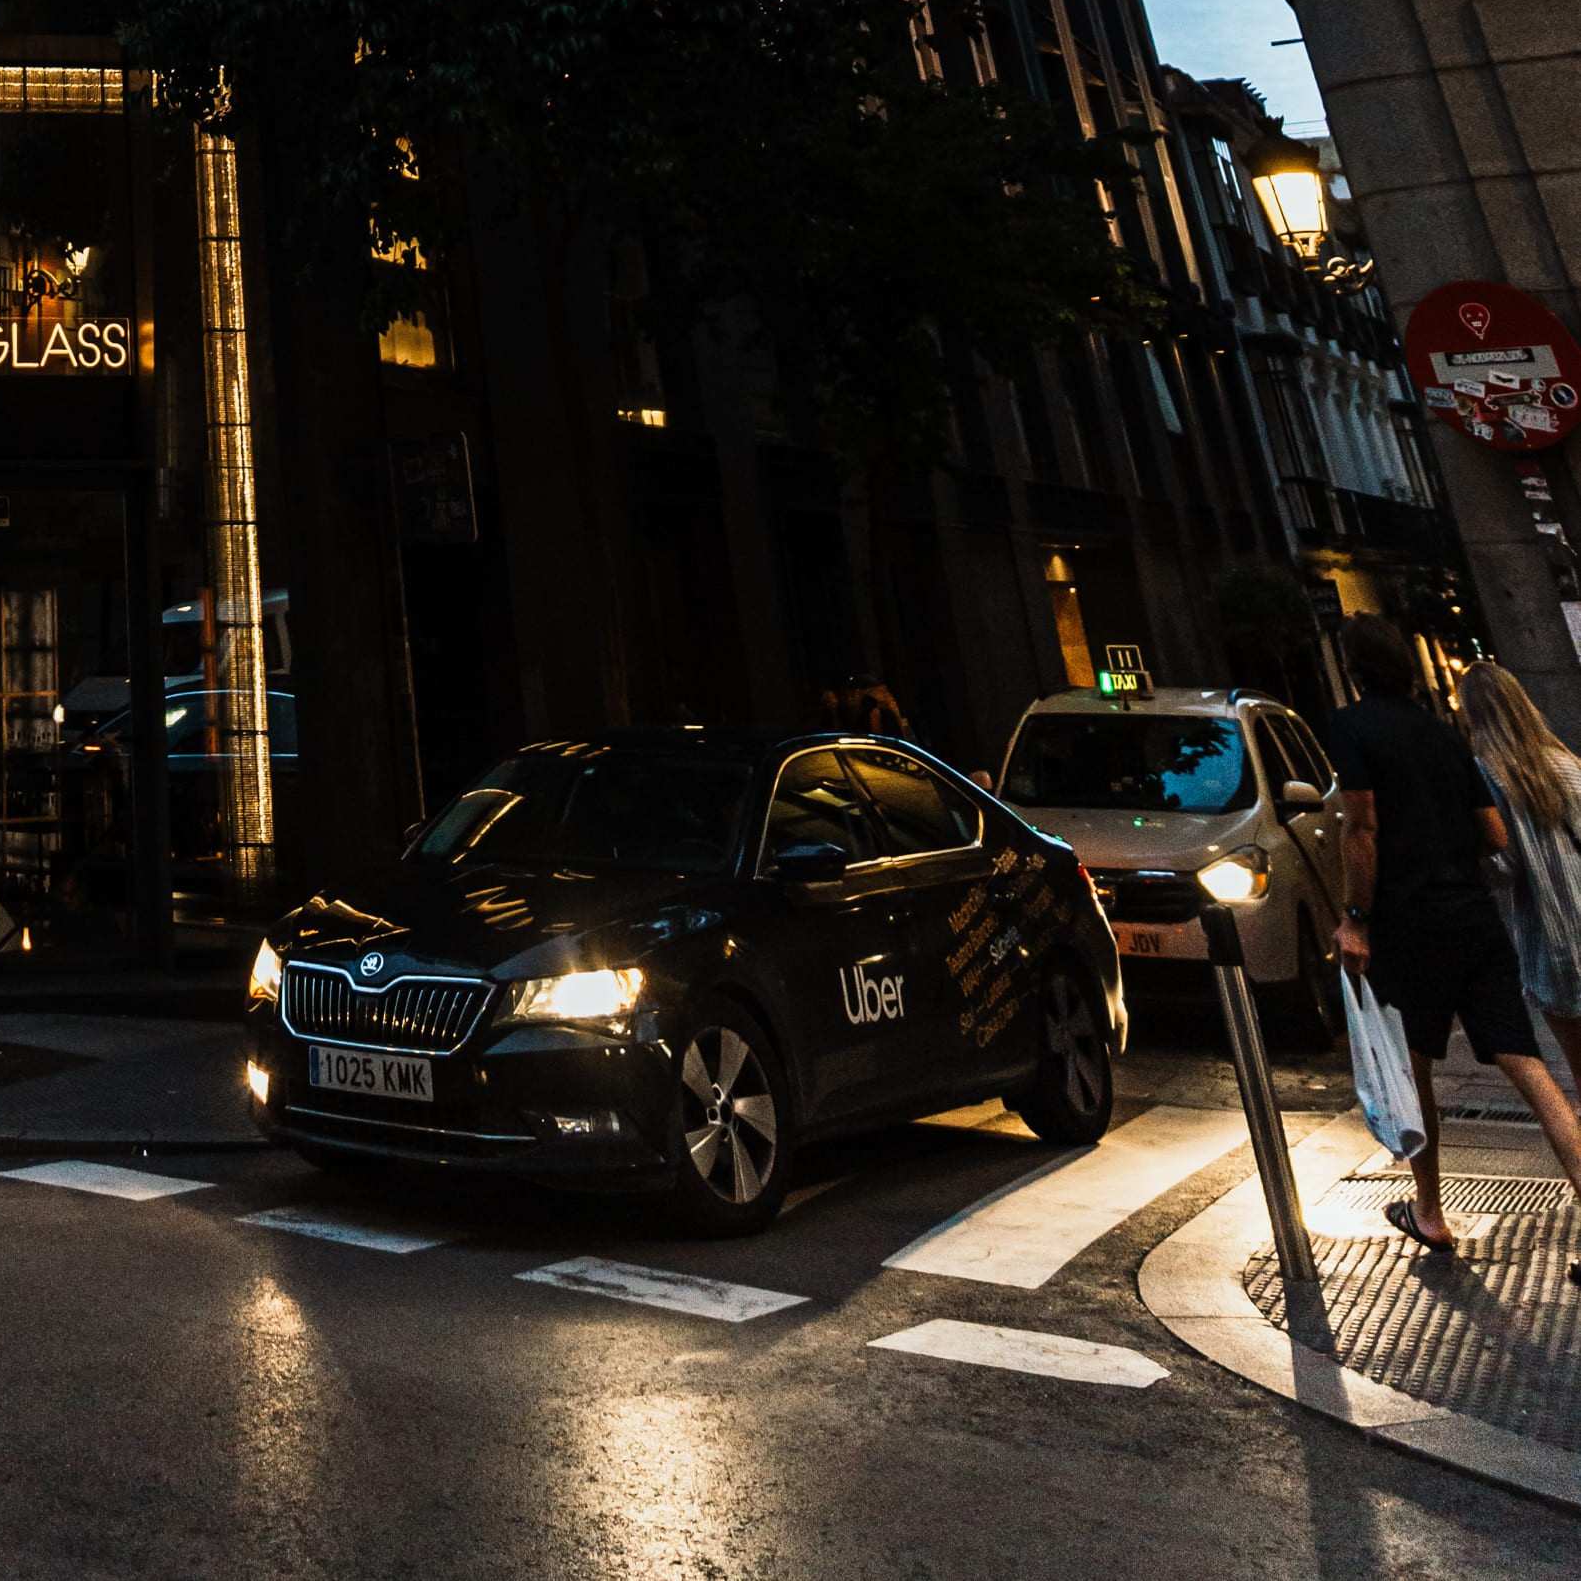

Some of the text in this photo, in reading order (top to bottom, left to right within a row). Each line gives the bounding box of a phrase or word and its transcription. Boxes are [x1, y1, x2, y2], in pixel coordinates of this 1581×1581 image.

[1110, 673, 1138, 690] TAXI
[839, 965, 905, 1025] Uber
[325, 1053, 427, 1095] 1025 KMK
